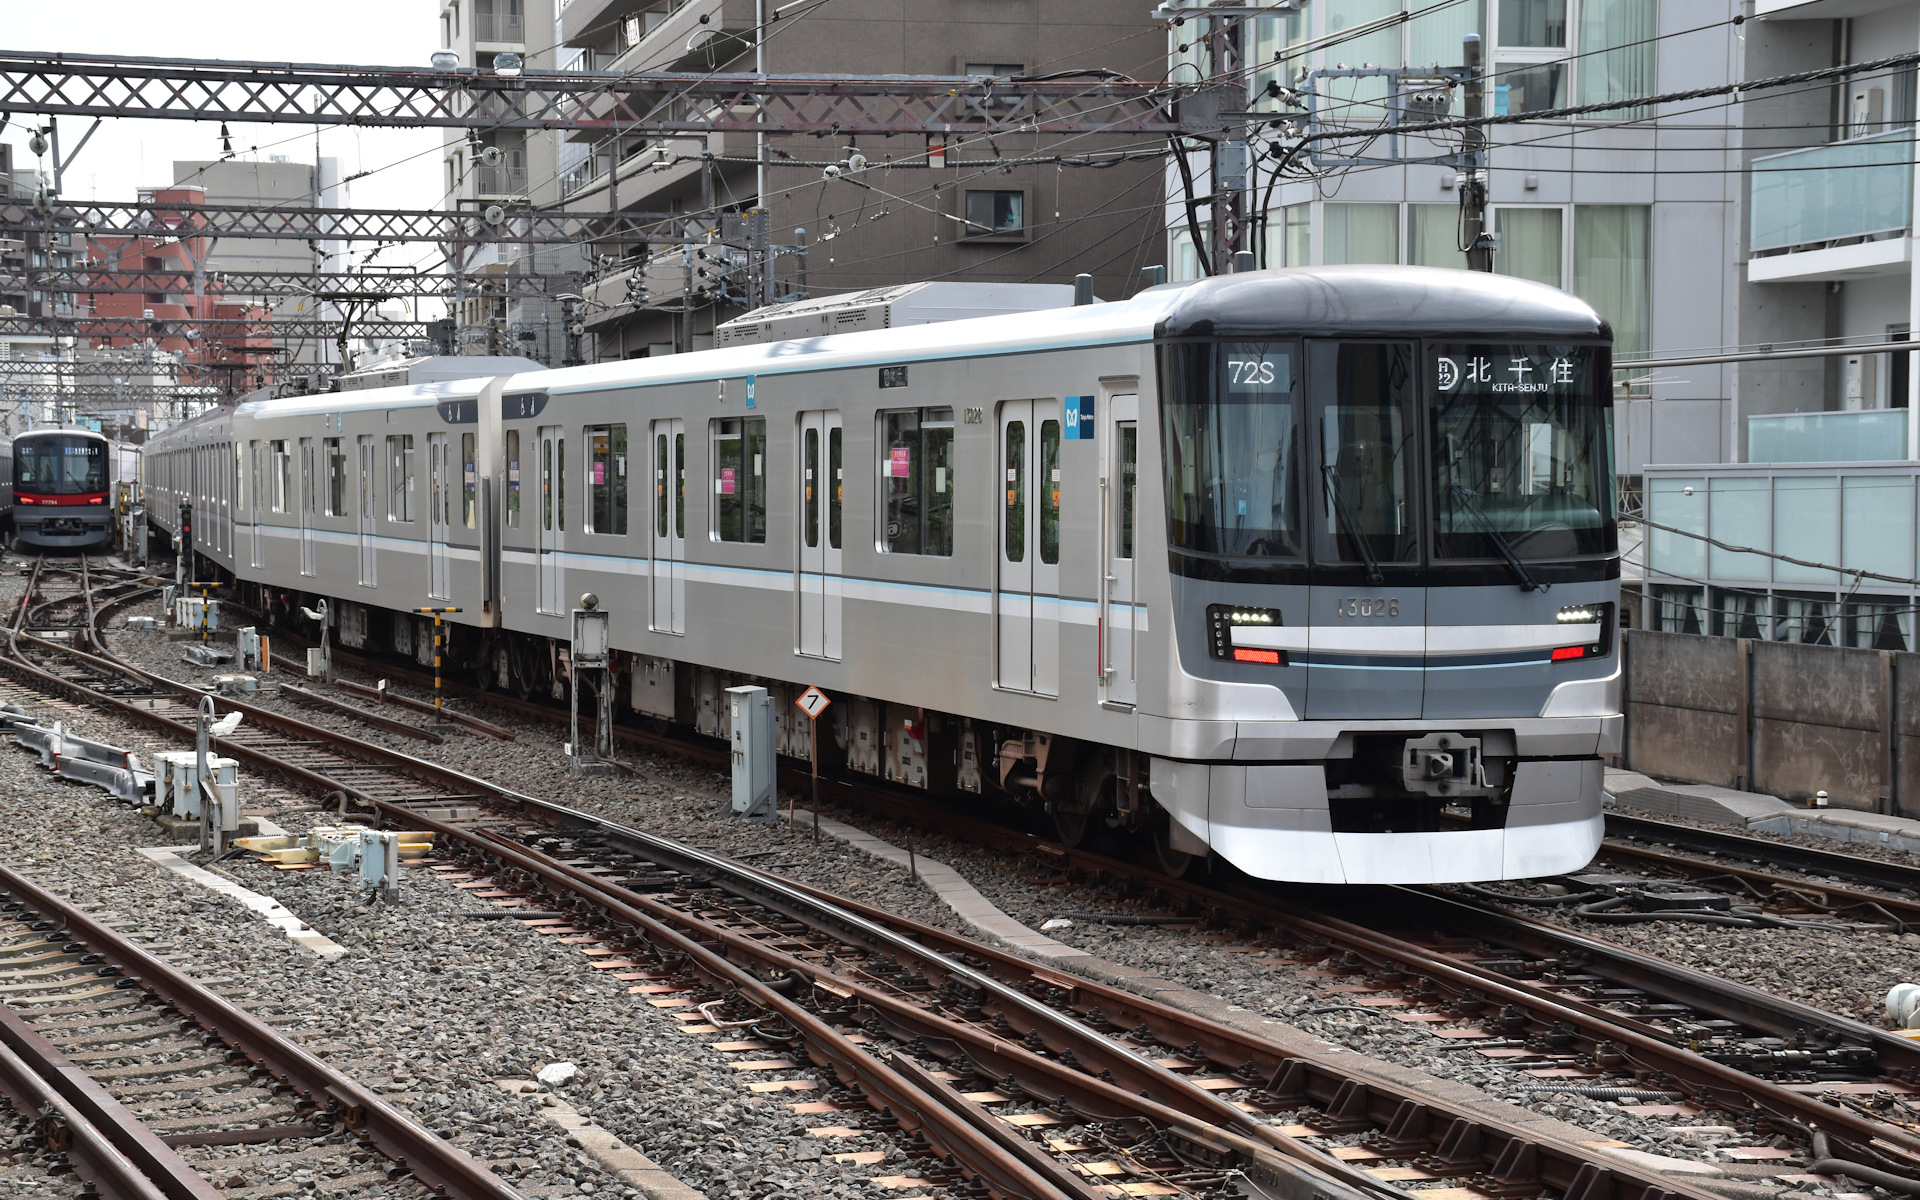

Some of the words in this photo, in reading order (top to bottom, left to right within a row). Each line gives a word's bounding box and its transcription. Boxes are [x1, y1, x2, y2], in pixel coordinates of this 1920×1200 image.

[1228, 361, 1275, 384] 72S
[1466, 356, 1574, 384] 北千住
[1492, 383, 1548, 392] KITA-SENJU
[1338, 598, 1400, 617] 13028
[807, 694, 819, 710] 7
